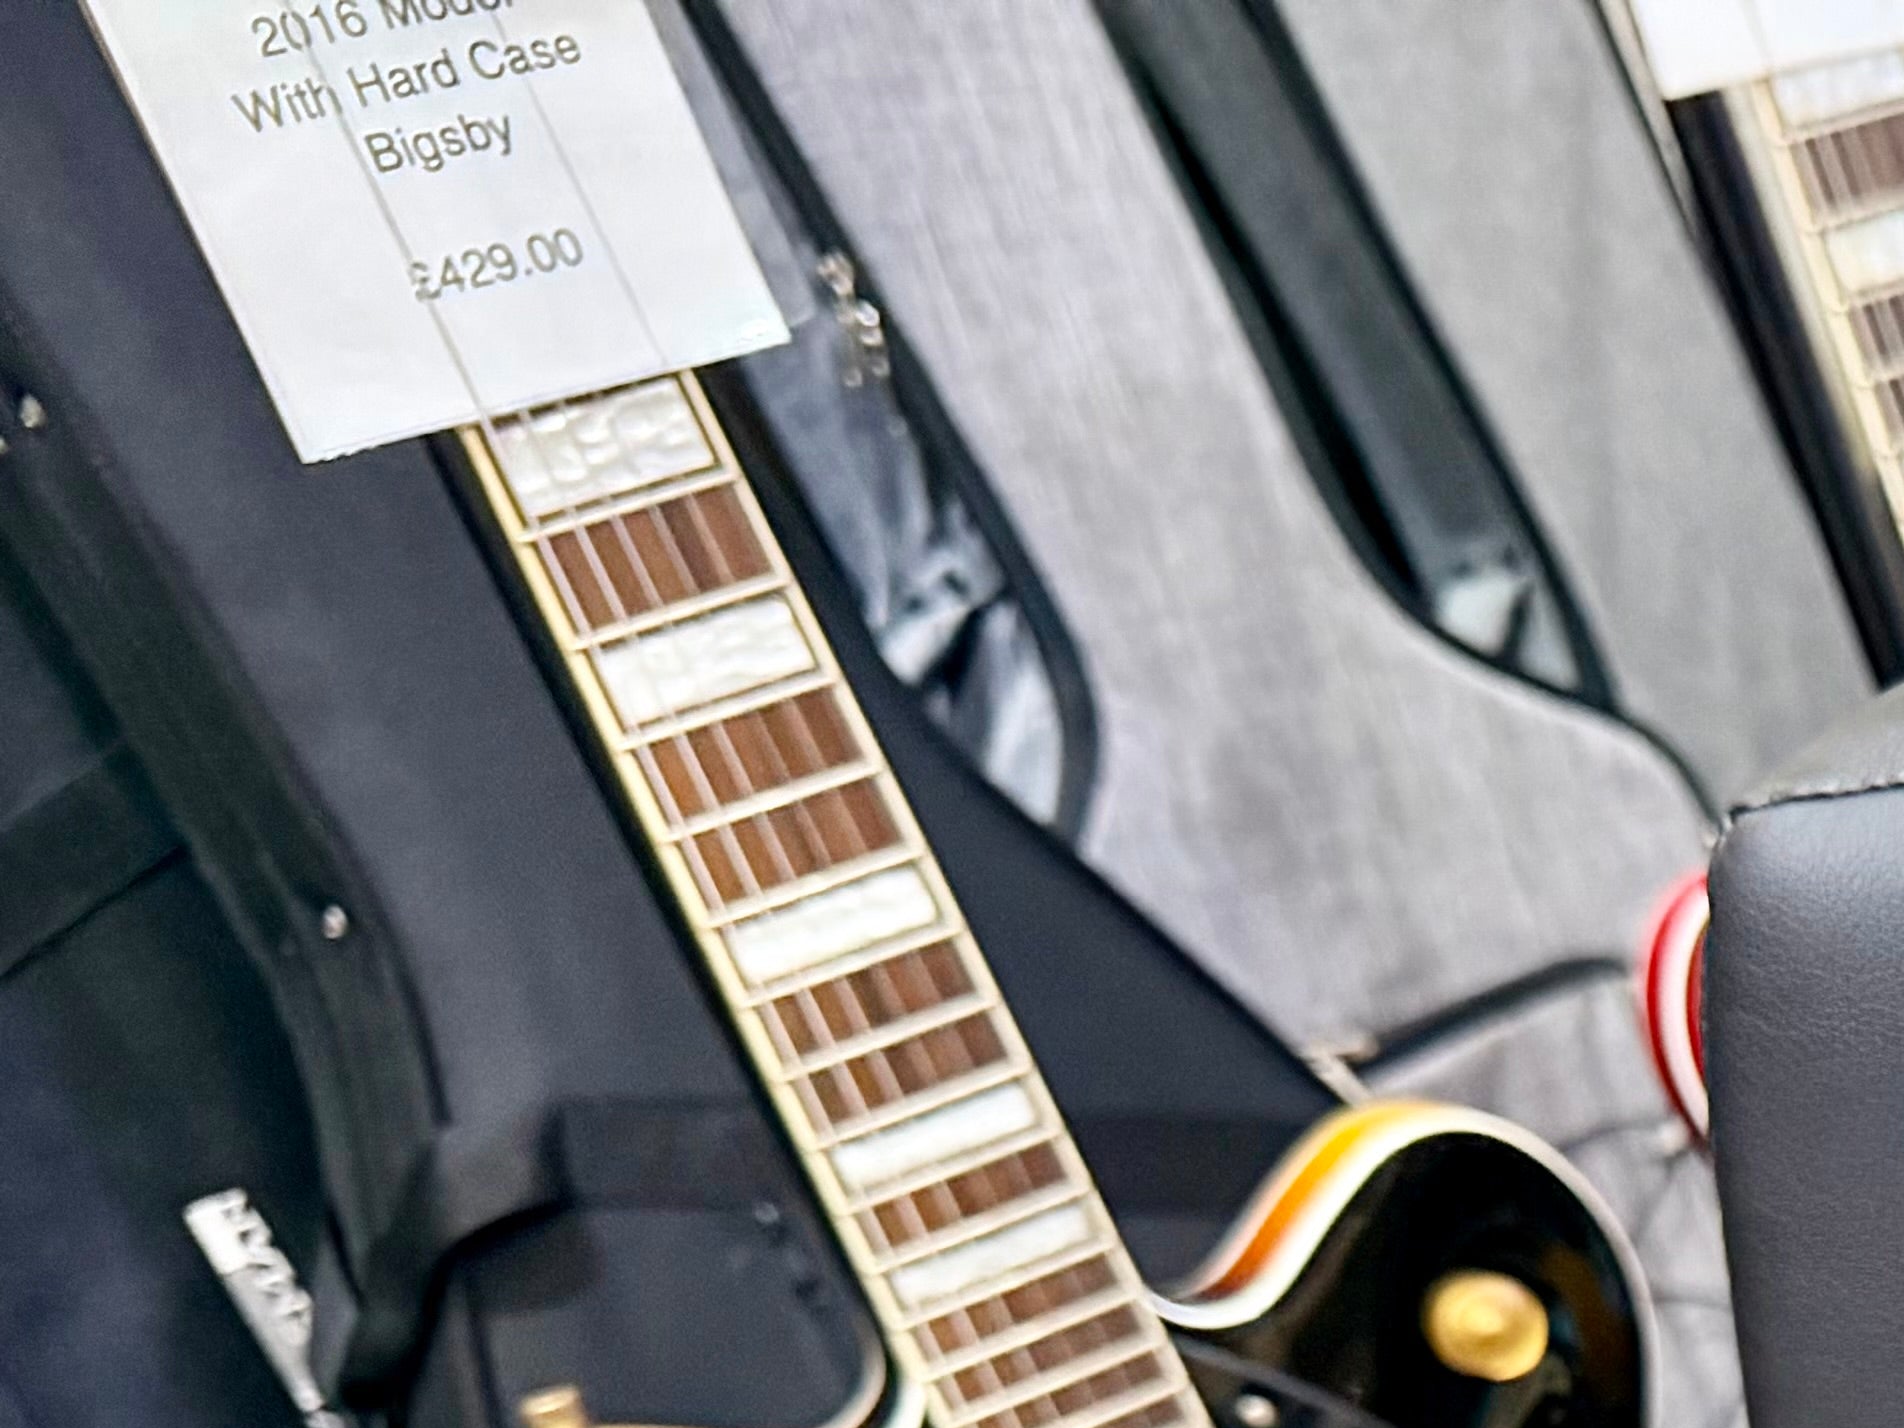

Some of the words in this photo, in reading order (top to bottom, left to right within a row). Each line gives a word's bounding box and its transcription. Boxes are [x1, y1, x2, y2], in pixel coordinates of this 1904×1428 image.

[251, 0, 368, 58] 2016
[231, 77, 343, 133] With
[346, 47, 461, 107] Hard
[468, 34, 581, 80] Case
[364, 114, 512, 173] Bigsby
[409, 227, 584, 301] £429.00
